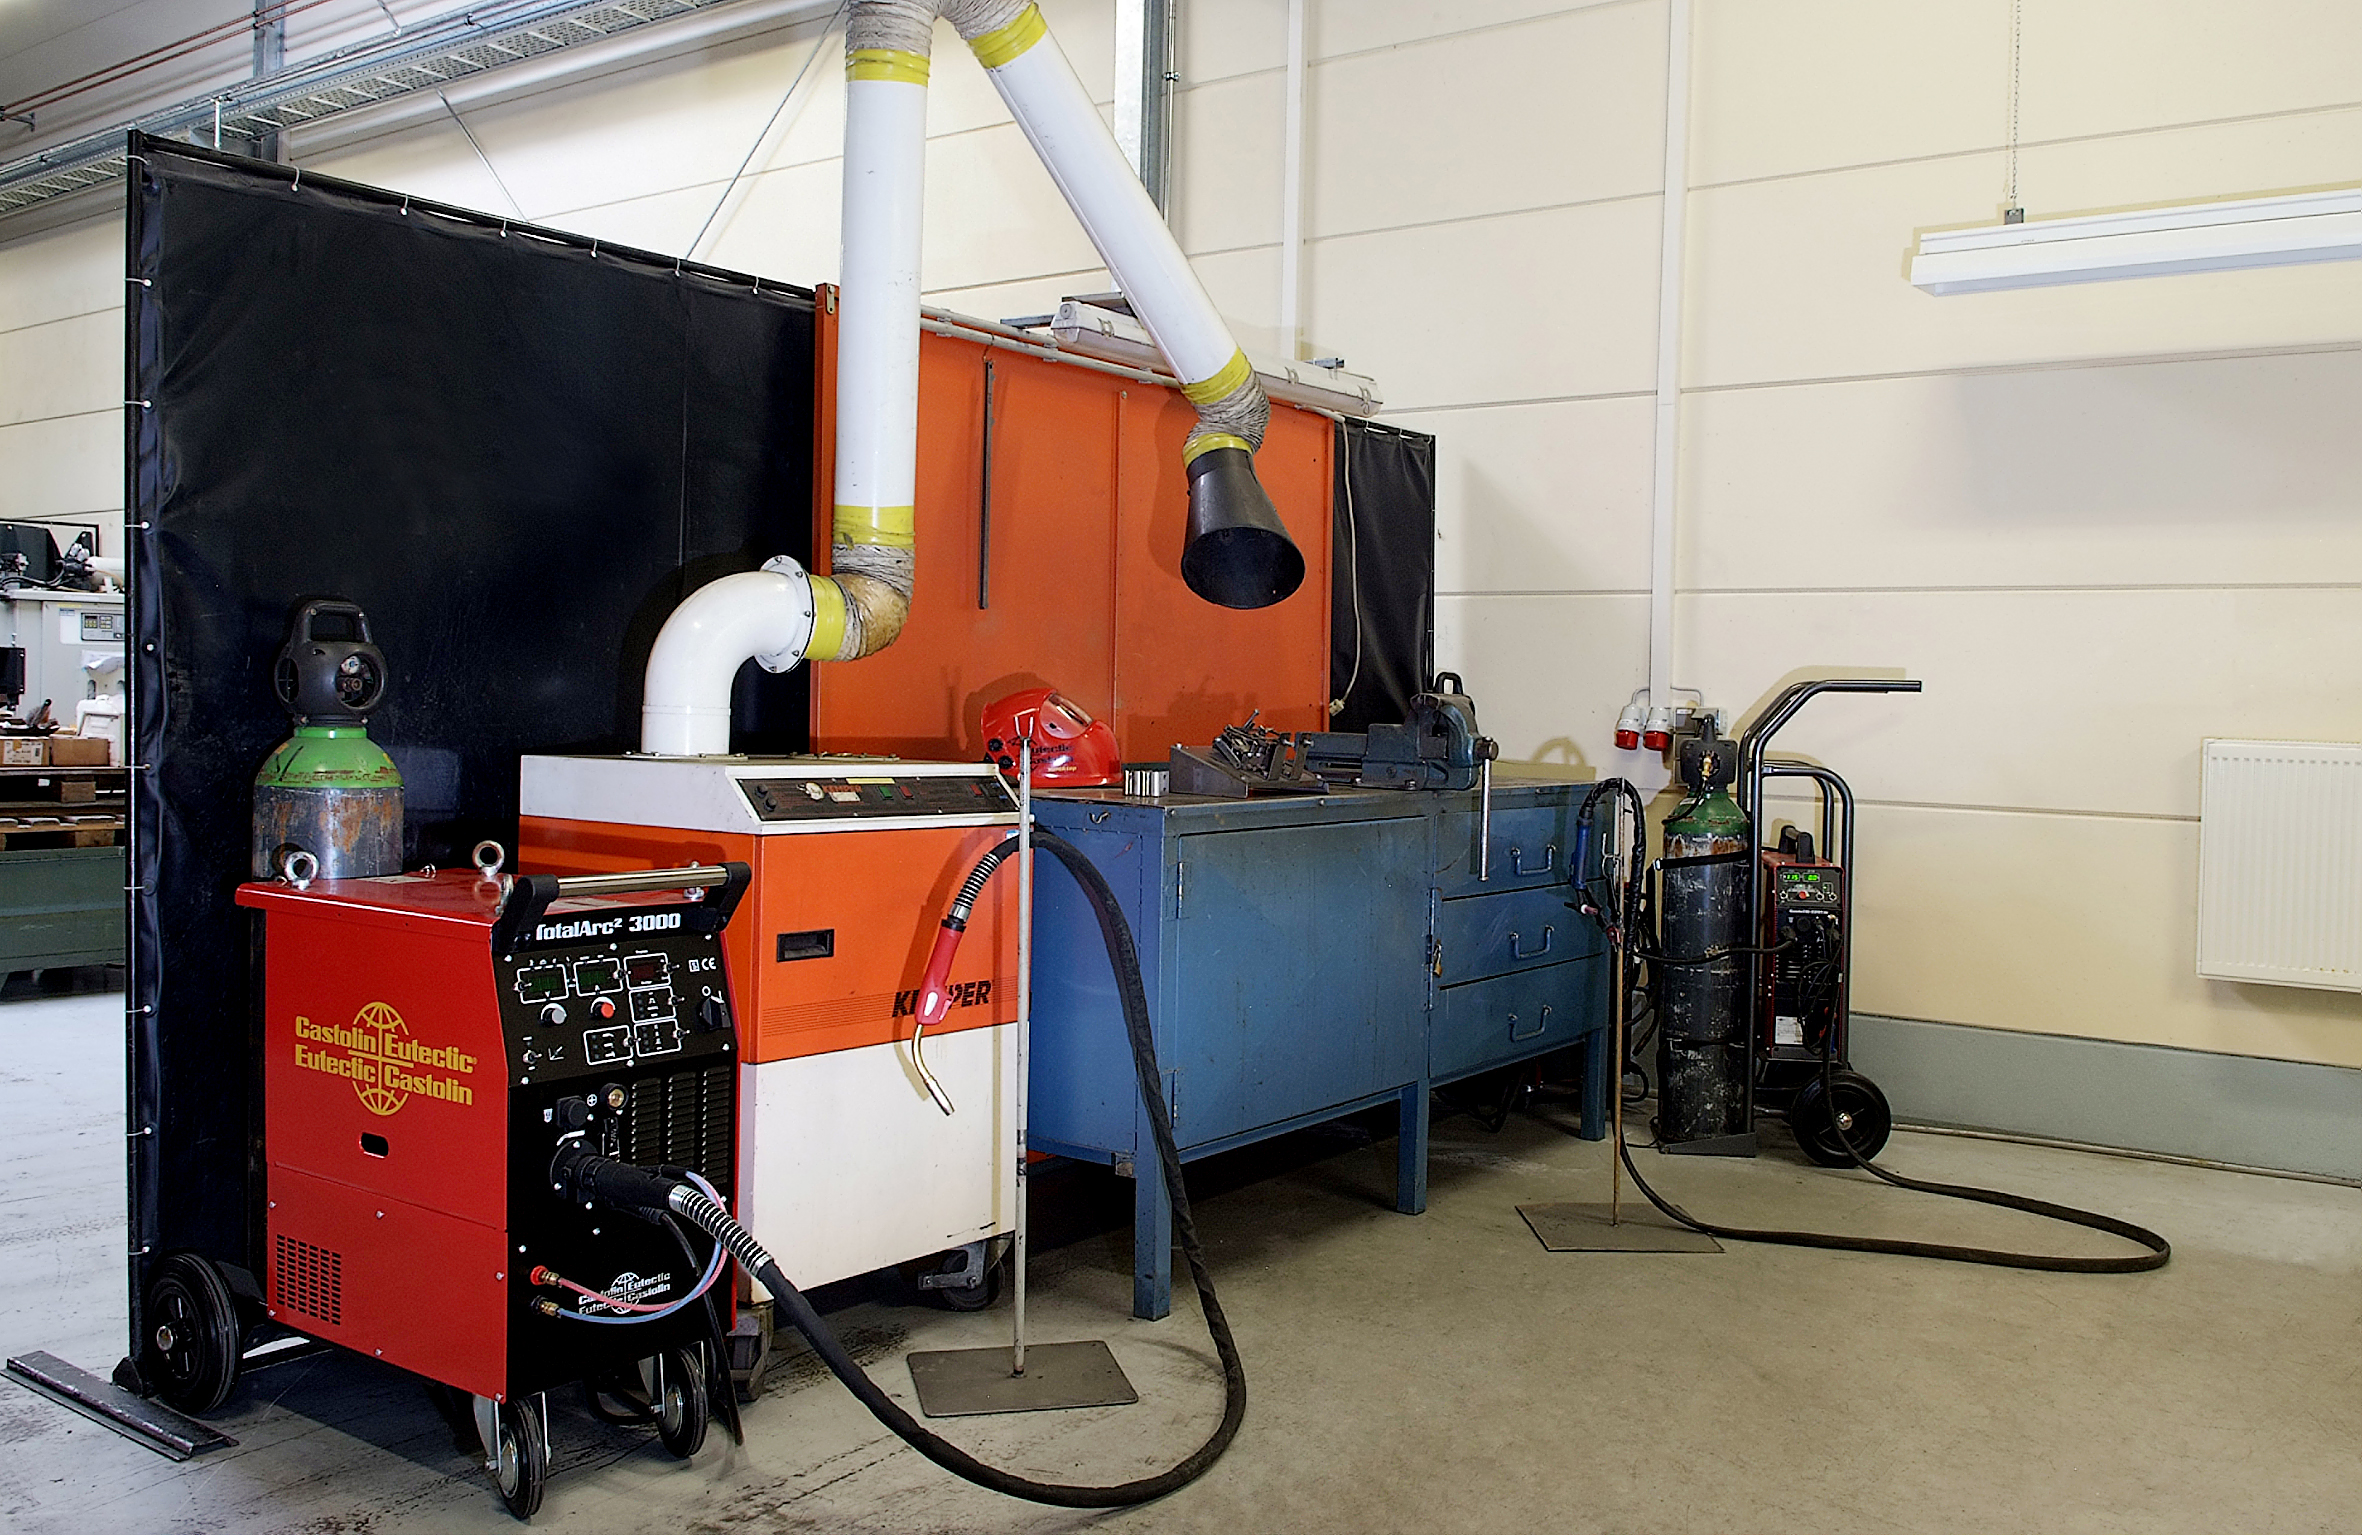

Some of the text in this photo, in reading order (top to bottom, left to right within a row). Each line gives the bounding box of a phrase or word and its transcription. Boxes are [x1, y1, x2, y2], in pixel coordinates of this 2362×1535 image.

[628, 913, 681, 932] 3000
[701, 957, 717, 970] CE
[892, 980, 992, 1017] KPER
[295, 1016, 474, 1074] Castolin Eutectic
[295, 1043, 473, 1106] Eutectic Castolin
[578, 1272, 670, 1305] Catolin Eutectic
[628, 1283, 670, 1302] Castolin
